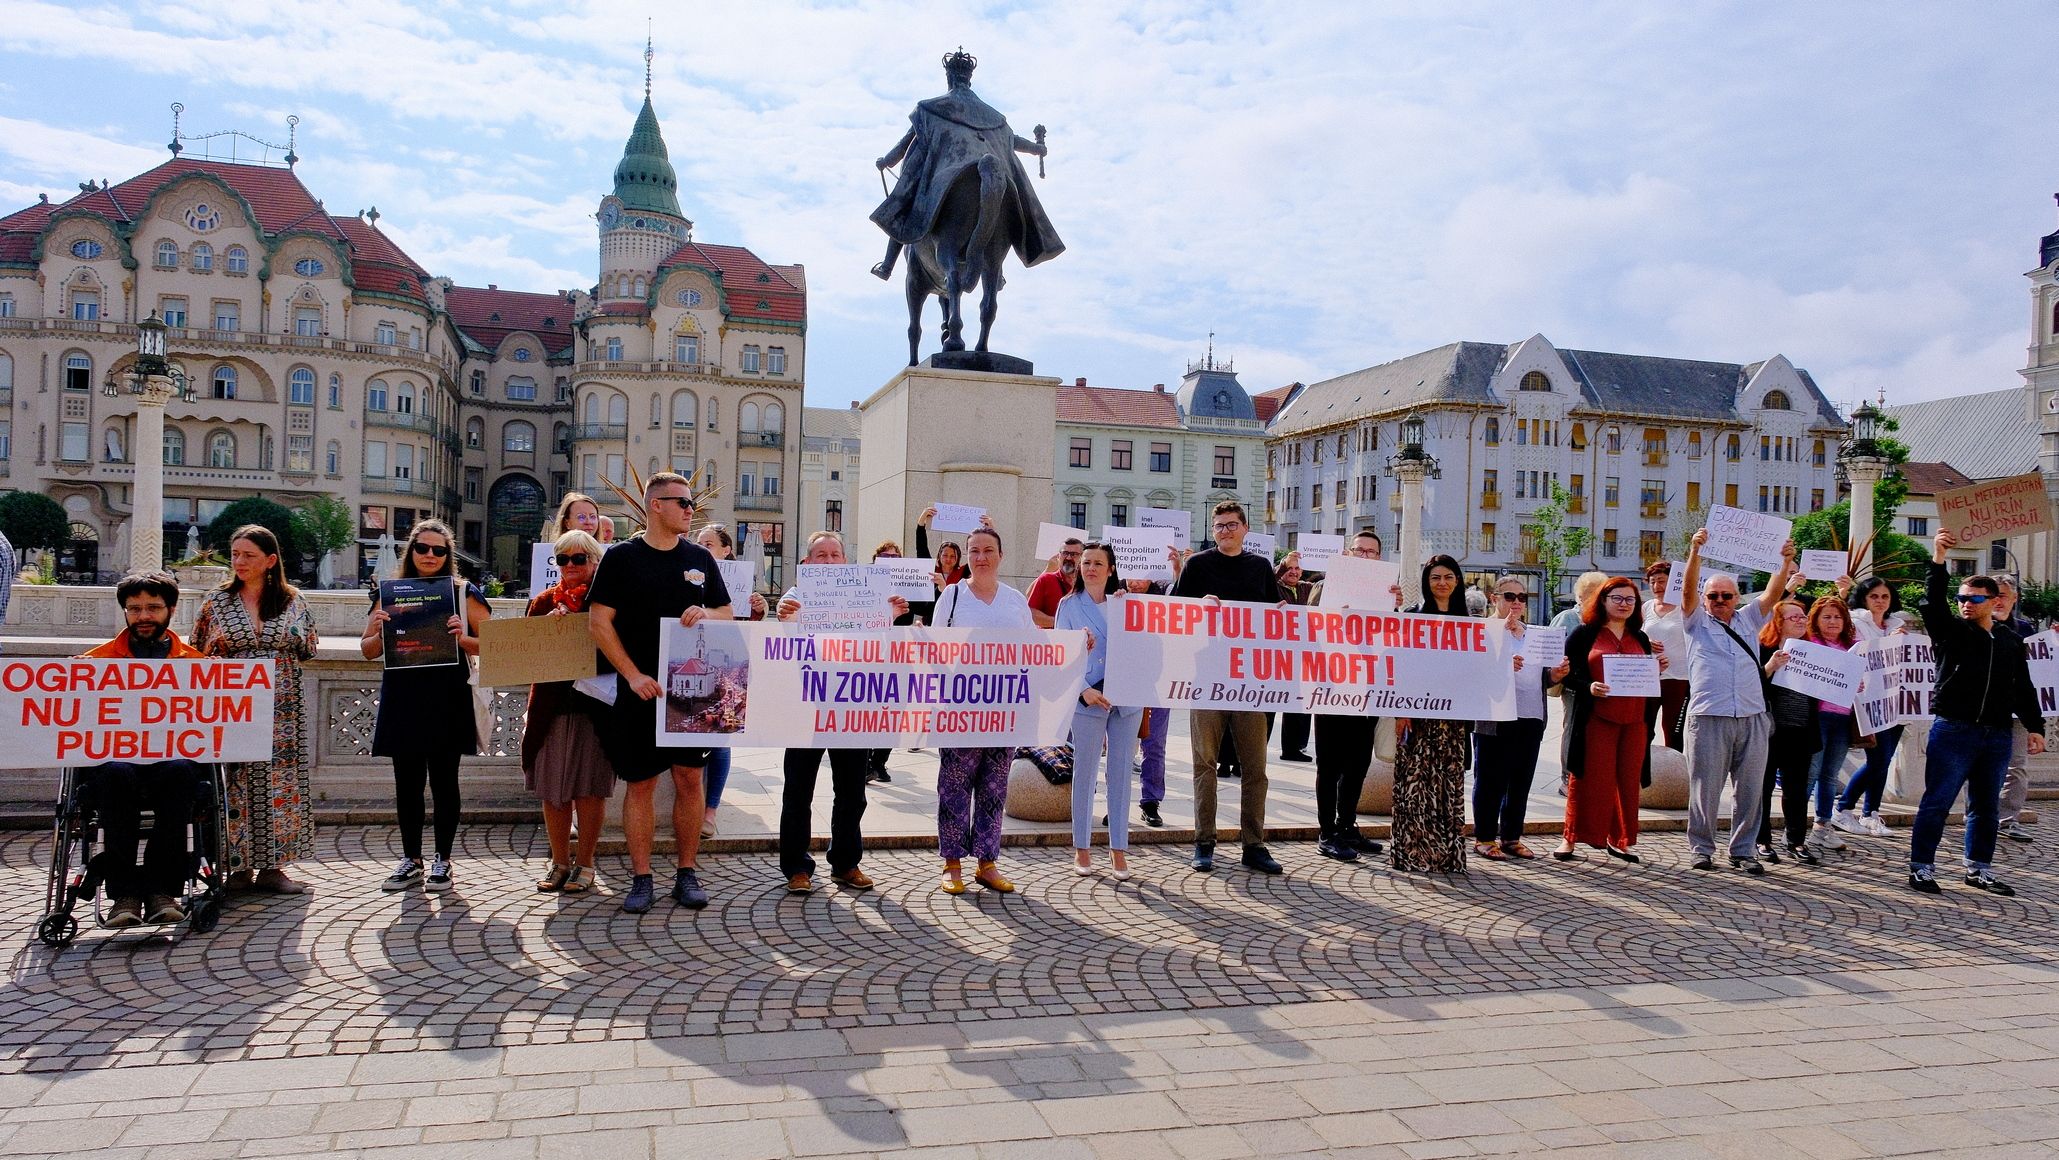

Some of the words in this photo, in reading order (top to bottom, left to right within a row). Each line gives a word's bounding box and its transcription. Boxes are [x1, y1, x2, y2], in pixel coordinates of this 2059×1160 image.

[1975, 478, 2042, 502] METROPOLITAN
[1712, 506, 1766, 530] BOLOJAN
[1970, 507, 1990, 522] NU
[1994, 497, 2022, 516] PRIN
[1719, 536, 1776, 556] EXTRAVILAN
[802, 613, 827, 621] STOP
[1124, 599, 1256, 640] DREPTUL
[1264, 609, 1300, 642] DE
[1307, 612, 1487, 652] PROPRIETATE
[764, 634, 816, 661] MUTĂ
[822, 638, 884, 664] INELUL
[890, 640, 1016, 666] METROPOLITAN
[1022, 643, 1065, 666] NORD
[1790, 648, 1808, 658] Inel
[1868, 650, 1885, 672] CARE
[1885, 648, 1894, 668] NU
[2, 662, 180, 692] OGRADA
[190, 662, 272, 690] MEA
[1230, 647, 1245, 679] E
[1252, 648, 1293, 681] UN
[1302, 650, 1378, 685] MOFT
[1784, 665, 1802, 674] prin
[1803, 671, 1848, 689] extravilan
[1789, 657, 1845, 680] Metropolitan
[1905, 669, 1924, 683] NU
[801, 664, 828, 702] ÎN
[834, 671, 900, 704] ZONA
[908, 668, 1030, 704] NELOCUITĂ
[1168, 680, 1203, 700] Ilie
[1209, 682, 1290, 708] Bolojan
[1306, 686, 1374, 712] filosof
[1376, 690, 1452, 711] iliescian
[21, 697, 80, 727] NU
[98, 698, 122, 726] E
[140, 696, 252, 724] DRUM
[1899, 685, 1922, 715] ÎN
[814, 710, 837, 734] LA
[842, 706, 932, 734] JUMĂTATE
[936, 710, 1005, 734] COSTURI
[56, 726, 224, 760] PUBLIC!
